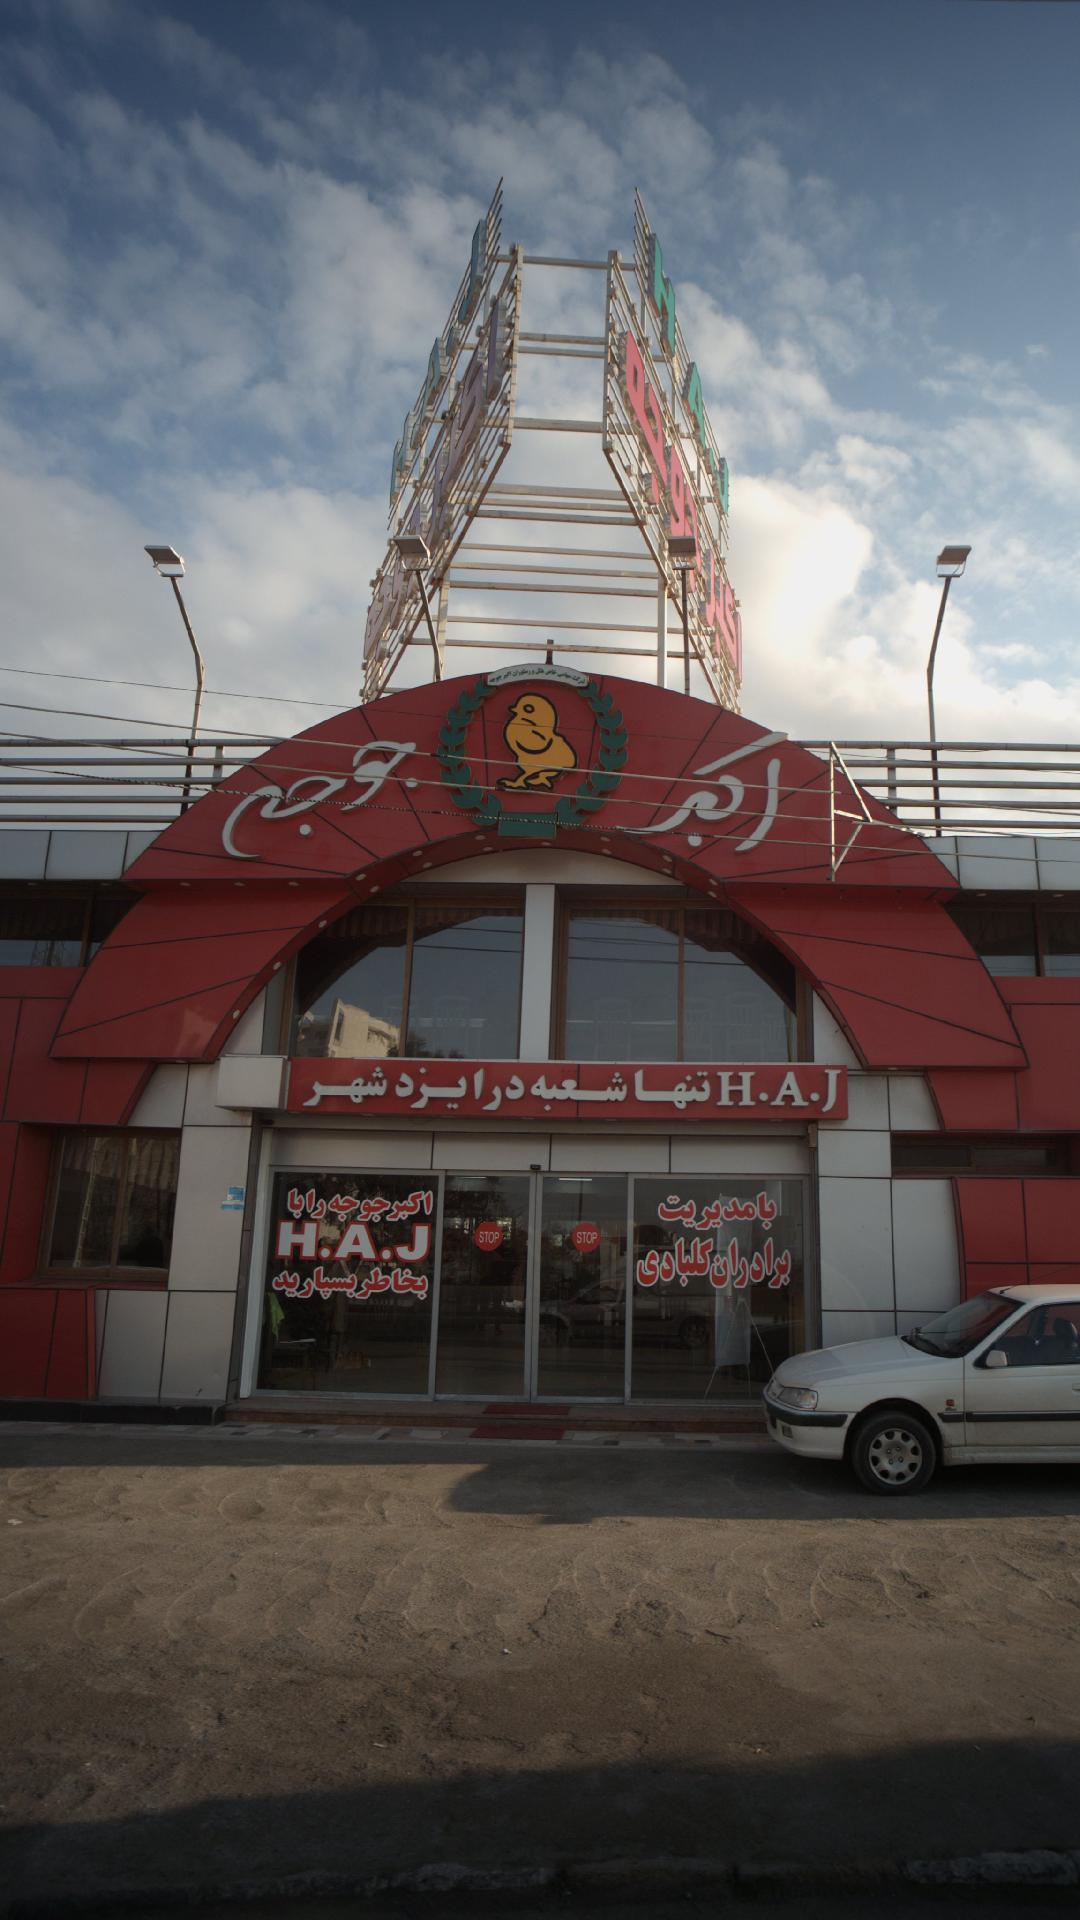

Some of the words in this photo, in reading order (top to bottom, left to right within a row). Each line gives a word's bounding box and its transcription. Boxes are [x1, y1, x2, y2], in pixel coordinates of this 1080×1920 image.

[222, 741, 418, 858] جوجه
[615, 732, 788, 851] اکبر
[482, 1075, 525, 1111] در
[530, 1072, 627, 1111] شعبه
[634, 1069, 711, 1109] تنها
[716, 1069, 841, 1112] H.A.J
[328, 1194, 391, 1222] جوجه
[386, 1190, 433, 1222] اکبر
[658, 1195, 757, 1230] مدیریت
[757, 1191, 777, 1230] با
[274, 1219, 432, 1262] H.A.J
[480, 1231, 500, 1244] STOP
[576, 1231, 598, 1244] STOP
[710, 1237, 792, 1288] برادران
[272, 1266, 357, 1300] بسپارید
[355, 1267, 428, 1300] بخاطر
